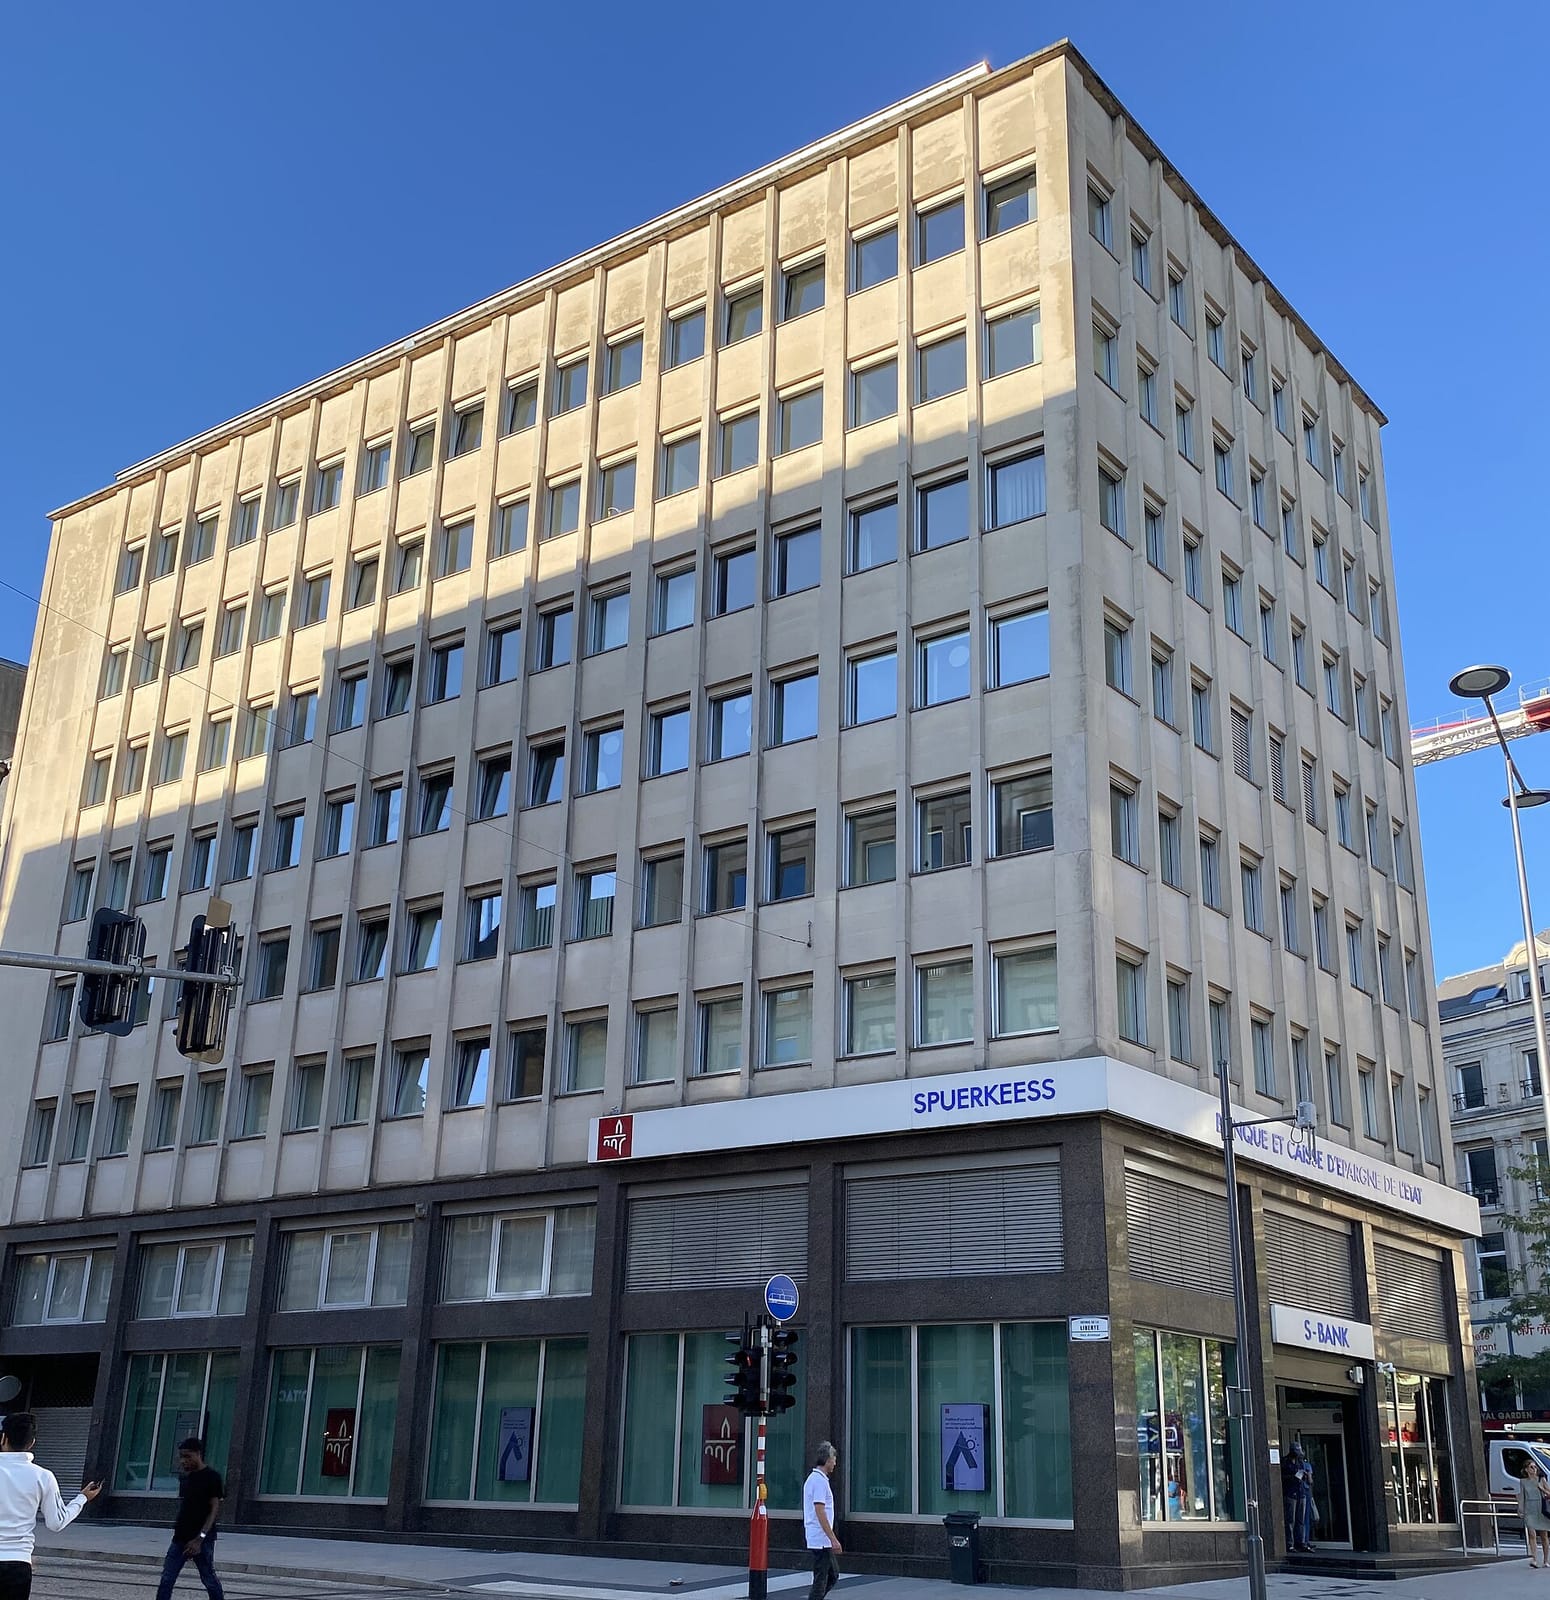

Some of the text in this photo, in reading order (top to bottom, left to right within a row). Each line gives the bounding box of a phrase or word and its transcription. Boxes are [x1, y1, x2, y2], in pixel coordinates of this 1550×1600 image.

[913, 1078, 1056, 1114] SPUERKEESS
[1215, 1112, 1268, 1150] BNQUE
[1271, 1133, 1284, 1155] ET
[1383, 1175, 1397, 1196] DE
[1303, 1319, 1350, 1348] S-BANK
[1474, 1343, 1497, 1352] urant
[1481, 1410, 1533, 1420] YAL GARDEN
